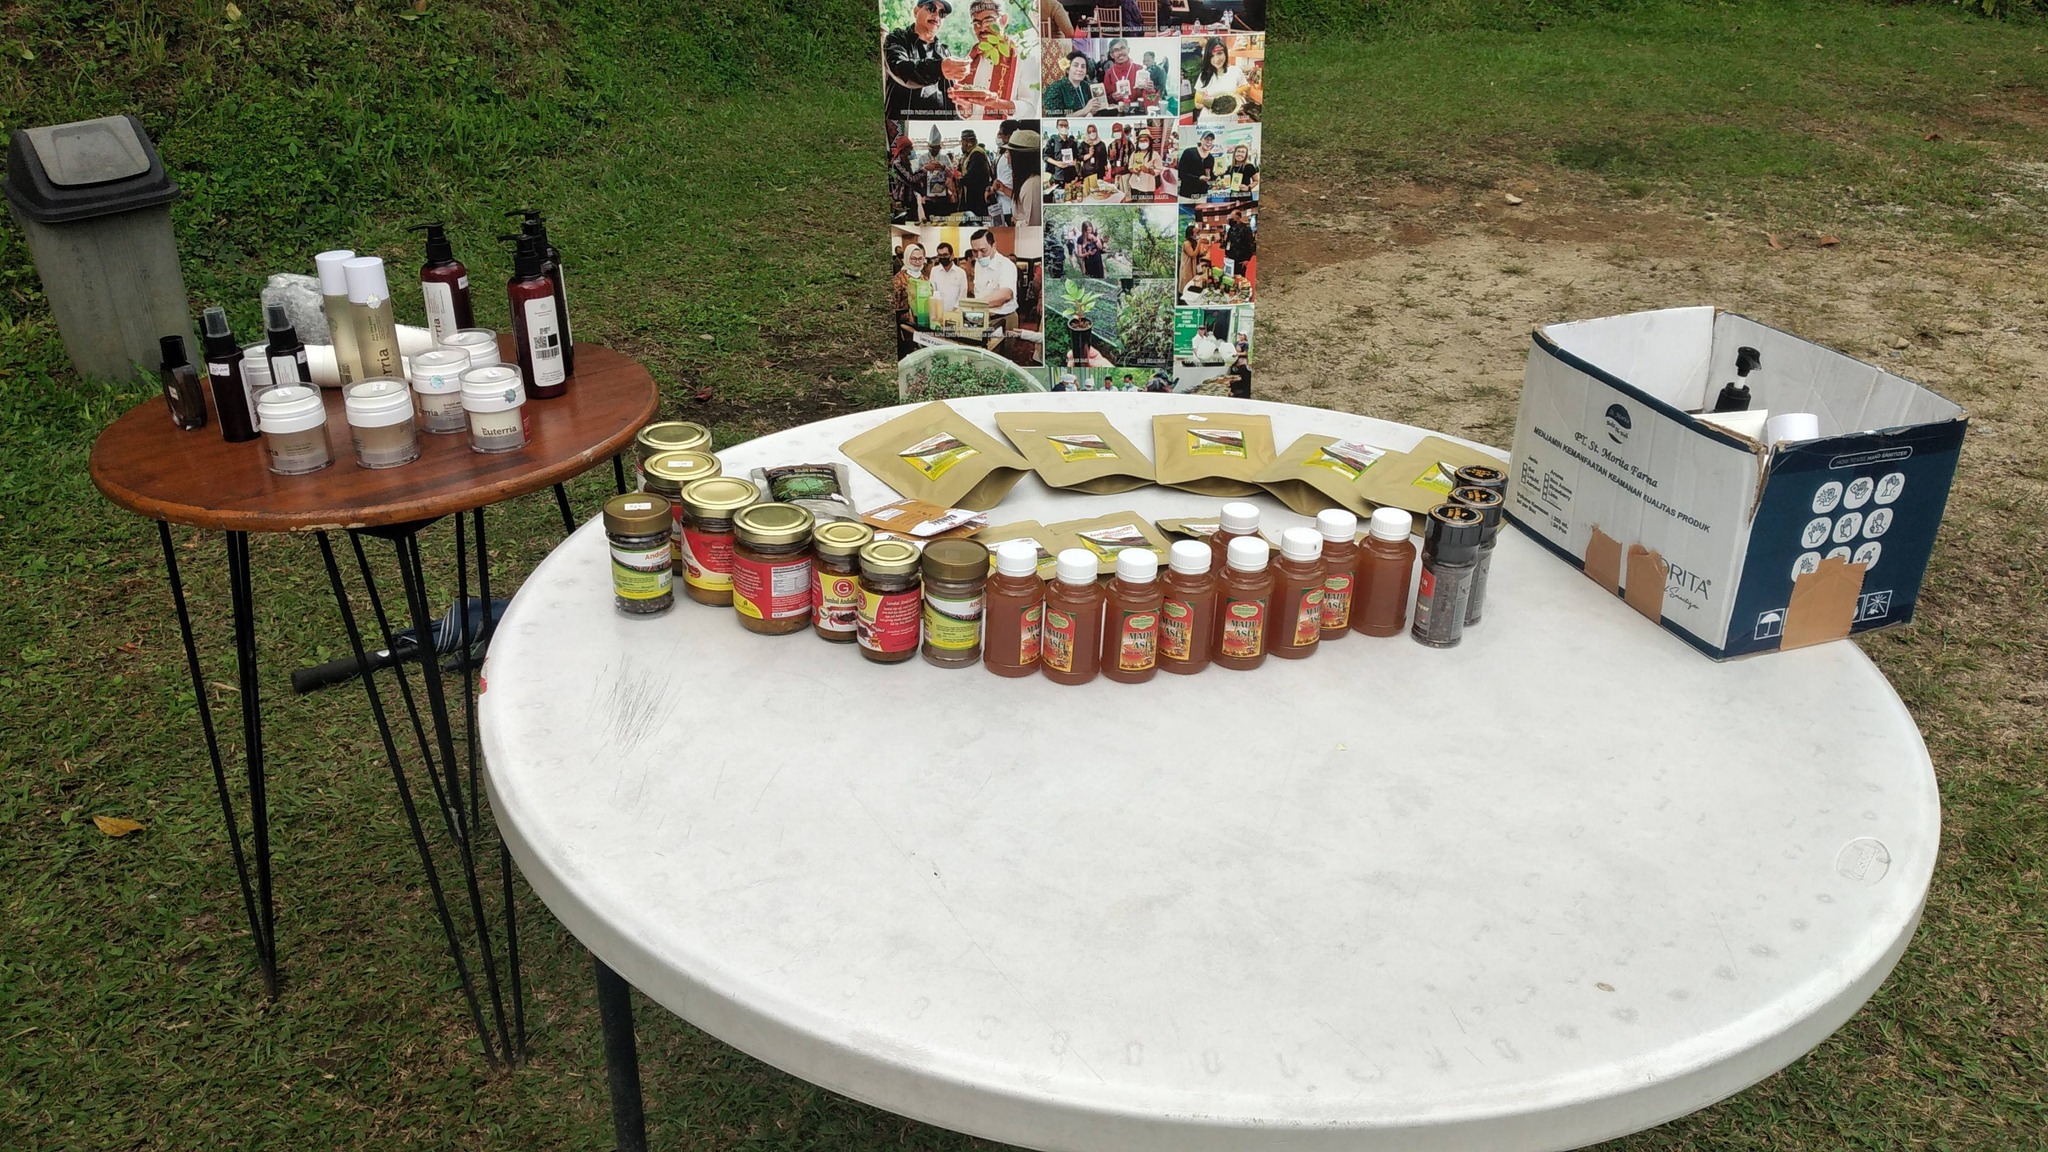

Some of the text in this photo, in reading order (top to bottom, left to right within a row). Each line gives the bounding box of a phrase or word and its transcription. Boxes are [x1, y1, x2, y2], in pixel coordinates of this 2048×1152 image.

[481, 425, 518, 436] Euterria
[1600, 446, 1630, 473] Morita
[1866, 454, 1881, 462] HAND
[1881, 450, 1908, 459] SANITIZER
[1533, 426, 1711, 536] MENJAMIN KEMANFAATAN KEAMANAN KUALITAS PRODUK
[1548, 490, 1558, 500] Lime
[1549, 484, 1571, 502] Strawberry
[1558, 483, 1573, 495] Aroma
[1323, 591, 1348, 601] MADU
[1160, 615, 1187, 631] MADU
[1230, 619, 1258, 629] MADU
[1127, 629, 1156, 641] MADU
[1235, 629, 1258, 638] ASLI
